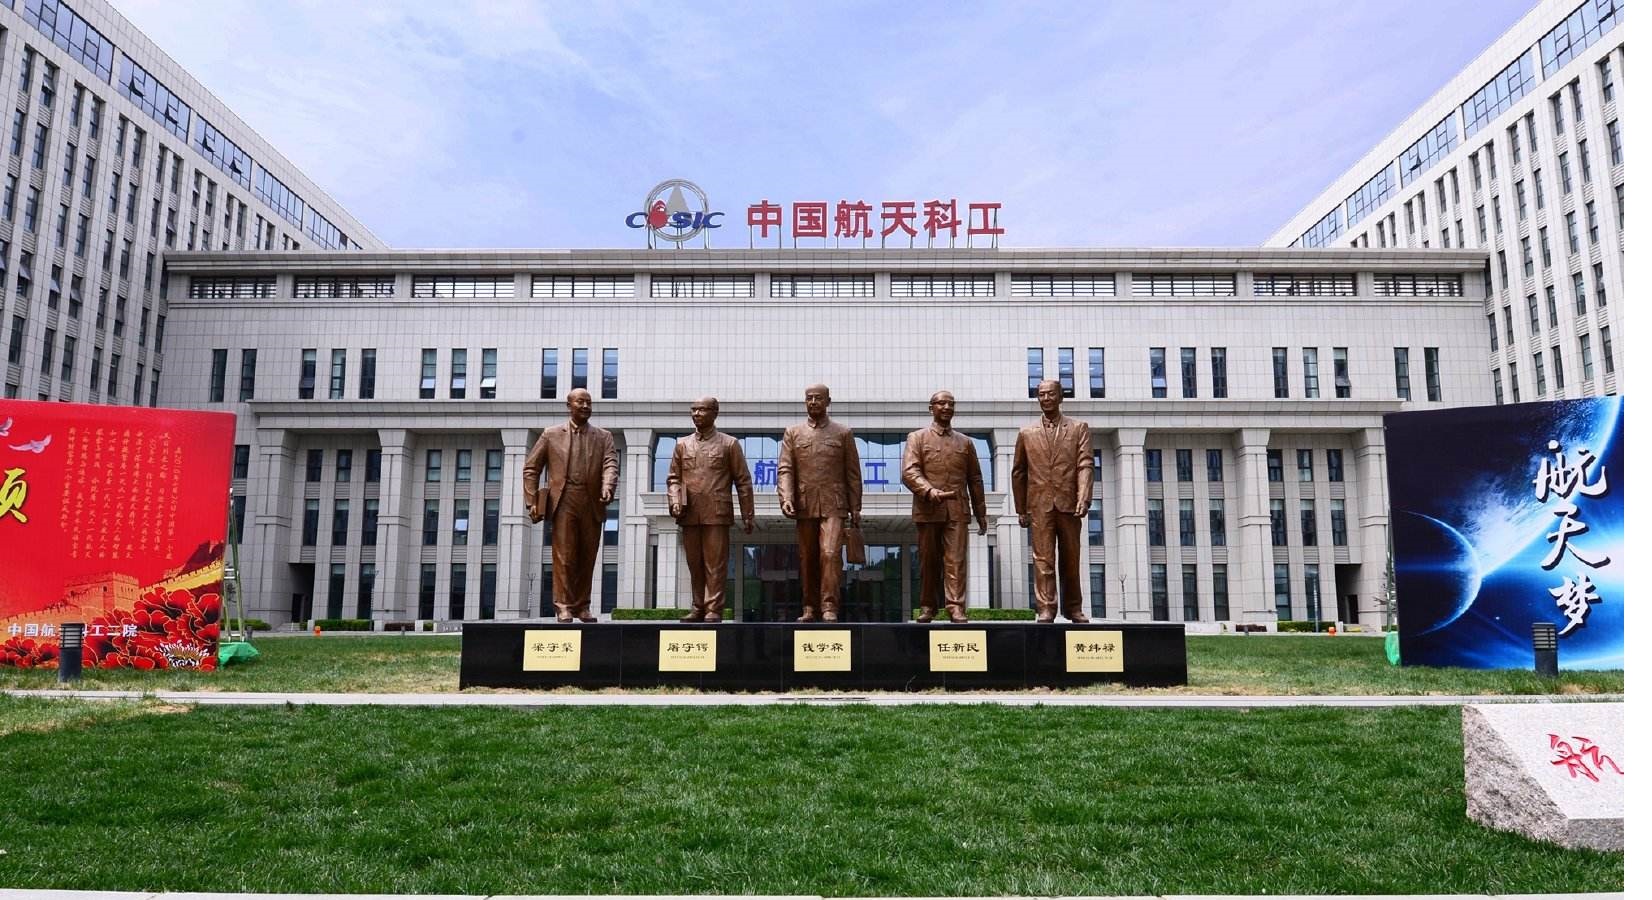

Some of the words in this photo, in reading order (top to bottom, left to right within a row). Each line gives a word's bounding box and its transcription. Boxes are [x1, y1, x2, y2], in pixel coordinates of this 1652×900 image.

[747, 199, 1005, 238] 中国航天科工
[1533, 440, 1611, 636] 航天梦
[7, 622, 138, 638] 中国航工二院
[801, 642, 844, 653] 钱学森
[936, 642, 980, 653] 任新民
[1073, 642, 1116, 654] 黄纬禄
